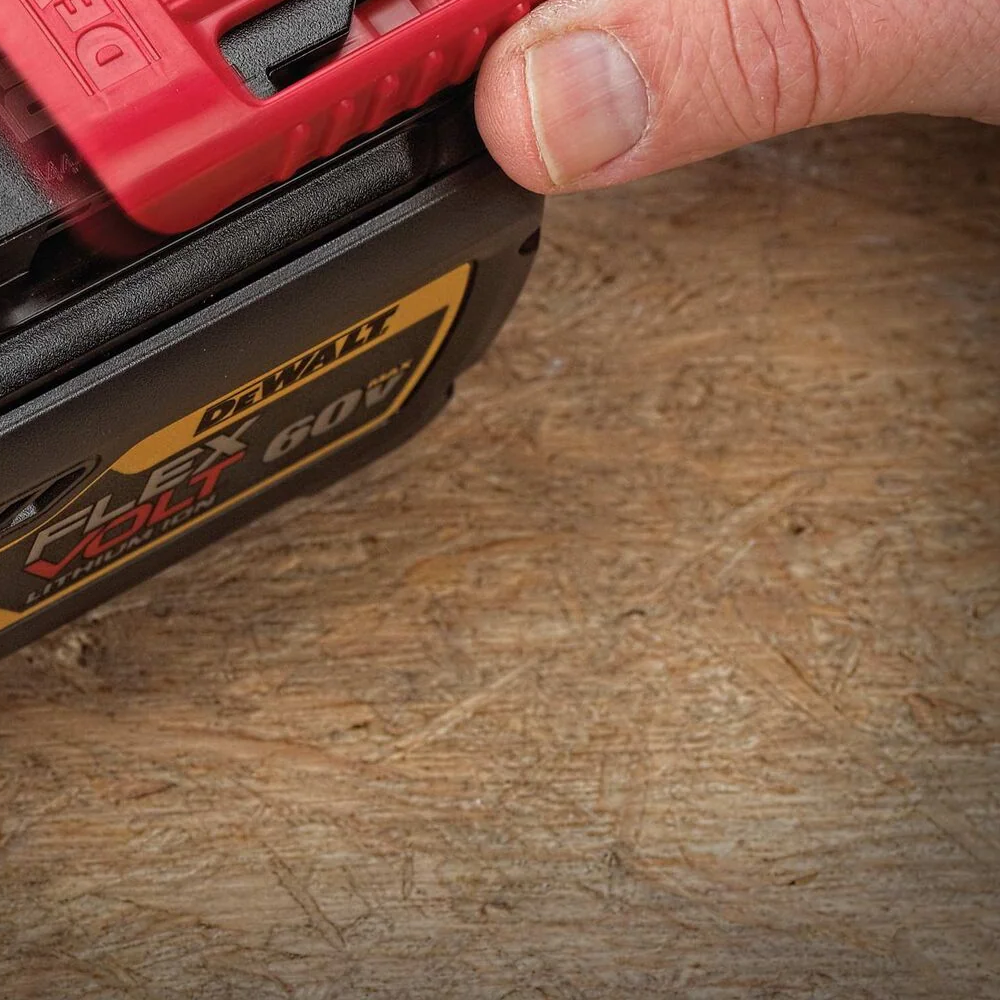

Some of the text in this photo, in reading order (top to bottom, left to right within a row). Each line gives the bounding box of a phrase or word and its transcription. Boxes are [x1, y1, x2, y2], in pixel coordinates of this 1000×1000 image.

[193, 306, 399, 438] DEWALT
[23, 450, 246, 580] VOLT
[25, 415, 260, 566] FLEX
